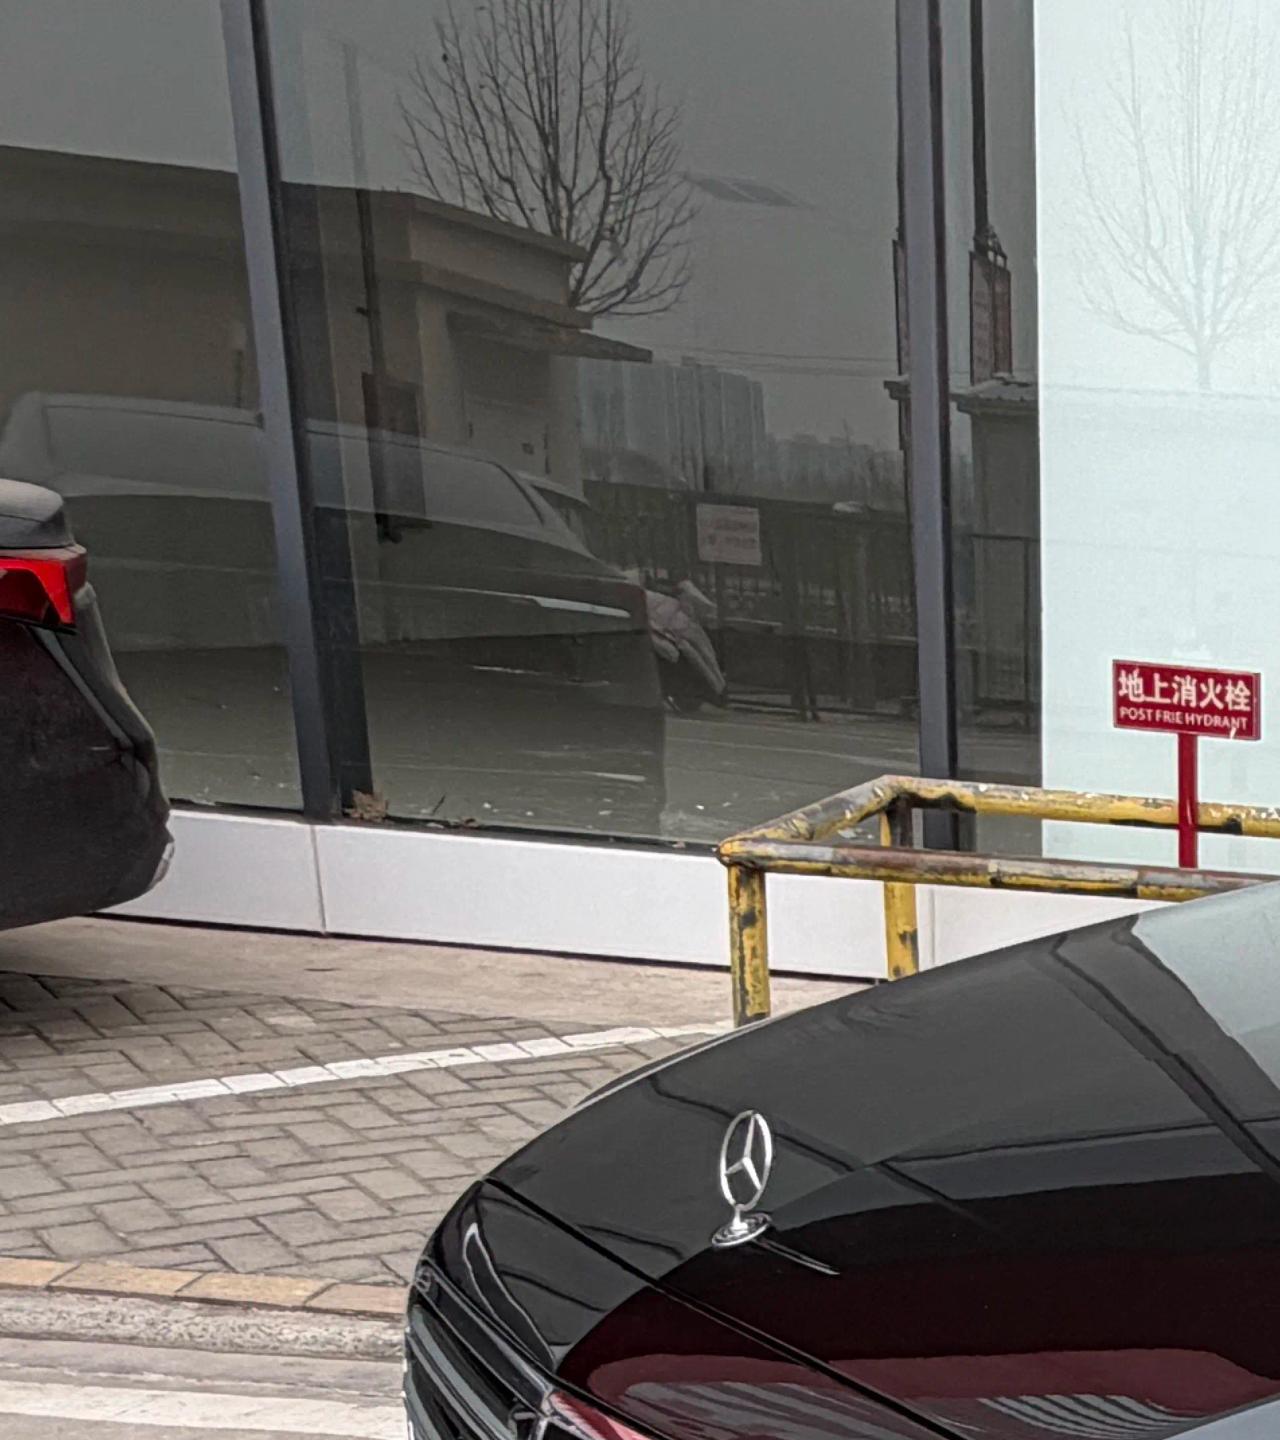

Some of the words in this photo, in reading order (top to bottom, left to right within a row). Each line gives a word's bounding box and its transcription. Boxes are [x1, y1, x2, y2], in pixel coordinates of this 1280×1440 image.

[1118, 668, 1251, 711] 地上消火栓
[1119, 706, 1152, 722] POST
[1155, 710, 1184, 725] FRIE
[1185, 712, 1248, 731] HYDRANT
